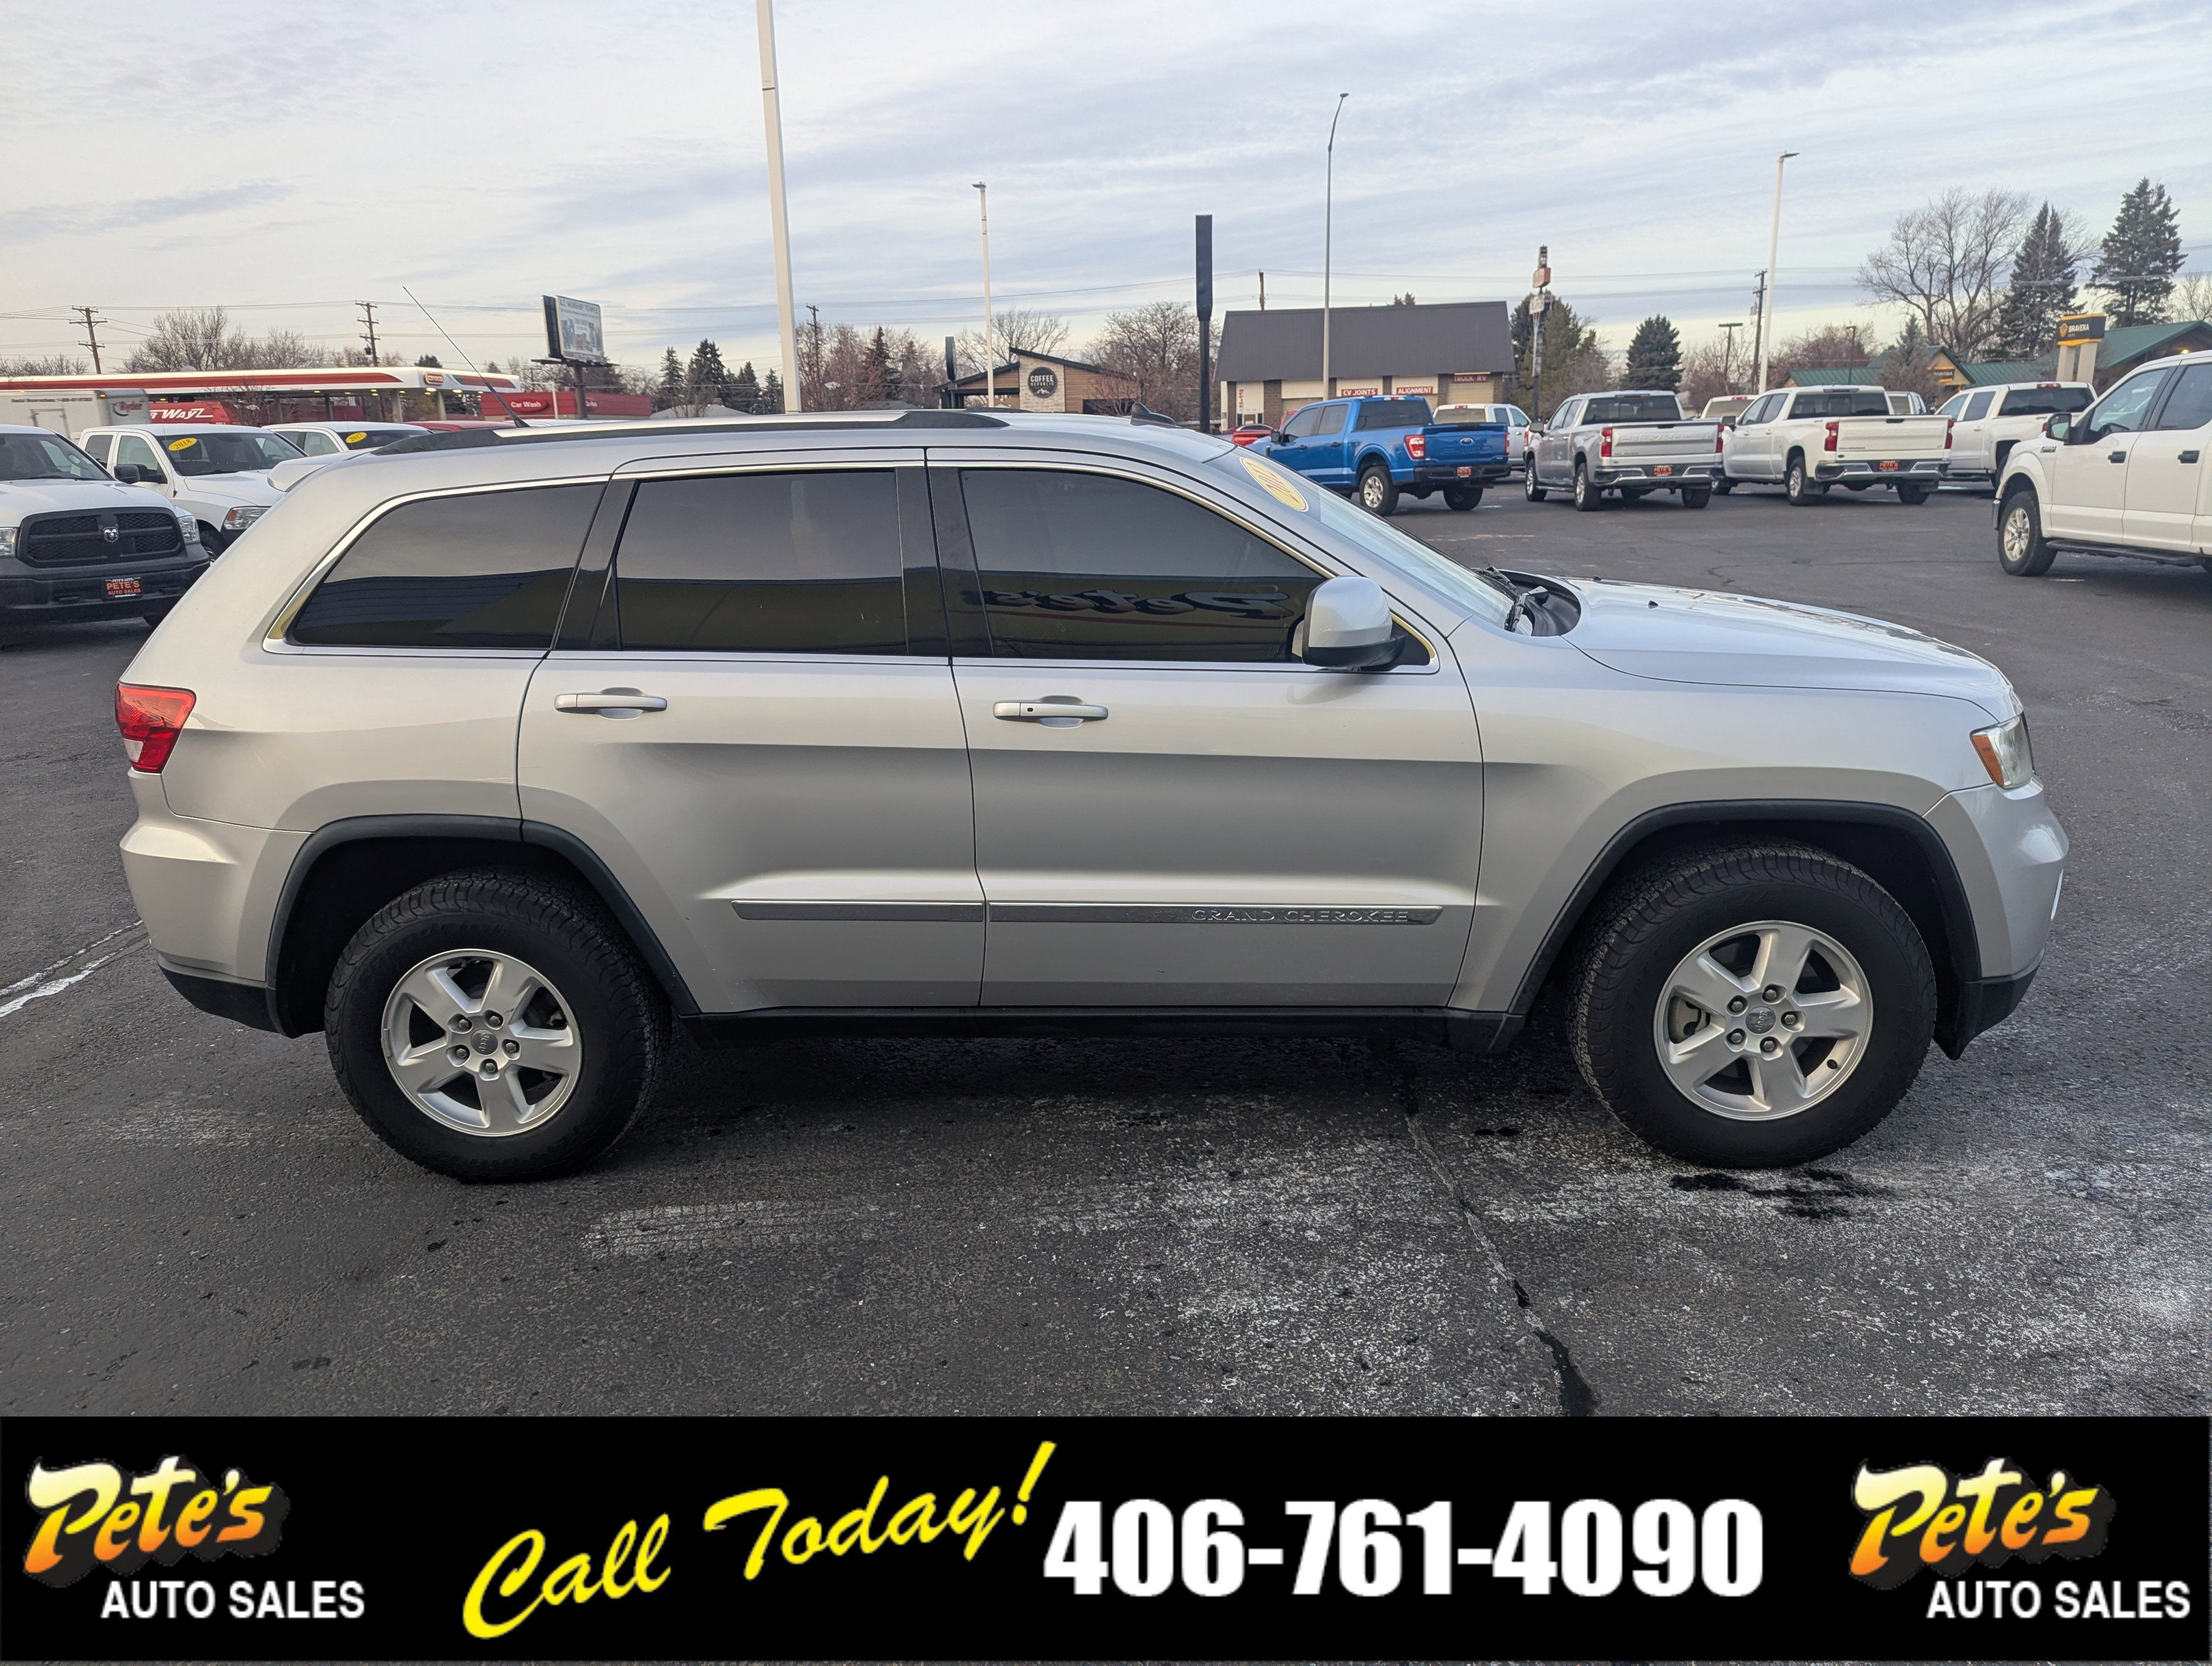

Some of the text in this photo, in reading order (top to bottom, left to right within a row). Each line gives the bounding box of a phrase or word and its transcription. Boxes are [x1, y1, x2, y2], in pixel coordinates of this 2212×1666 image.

[173, 439, 192, 449] 2018
[106, 580, 140, 590] PETE'S
[1191, 910, 1408, 922] GRAND CHEROKEE
